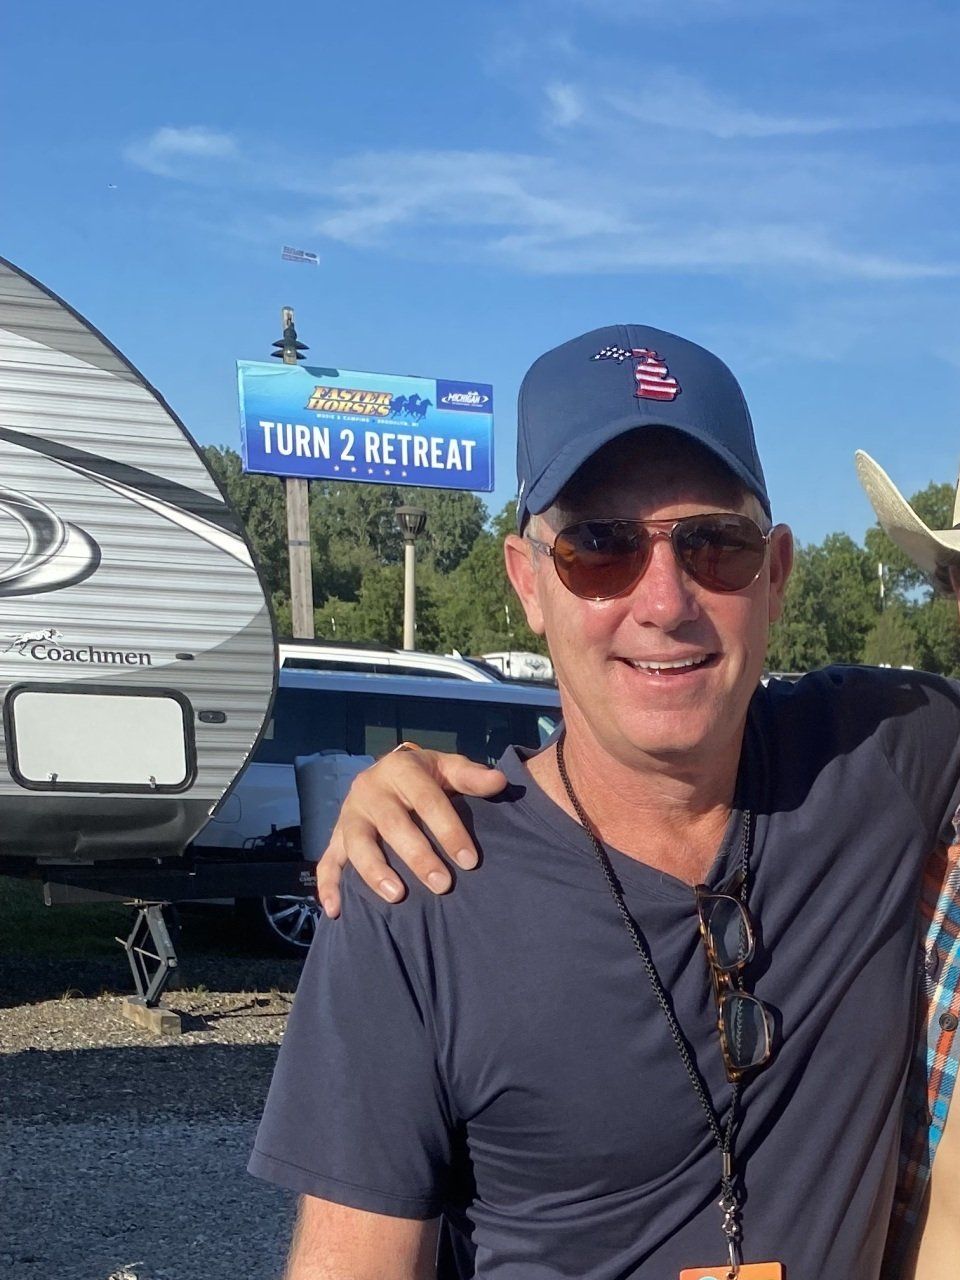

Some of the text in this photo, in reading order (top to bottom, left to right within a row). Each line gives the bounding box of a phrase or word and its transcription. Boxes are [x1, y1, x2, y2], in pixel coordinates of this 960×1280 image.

[311, 387, 392, 405] FASTER
[307, 399, 392, 416] HORSES
[259, 421, 476, 471] TURN 2 RETREAT
[30, 644, 153, 666] Coachmen
